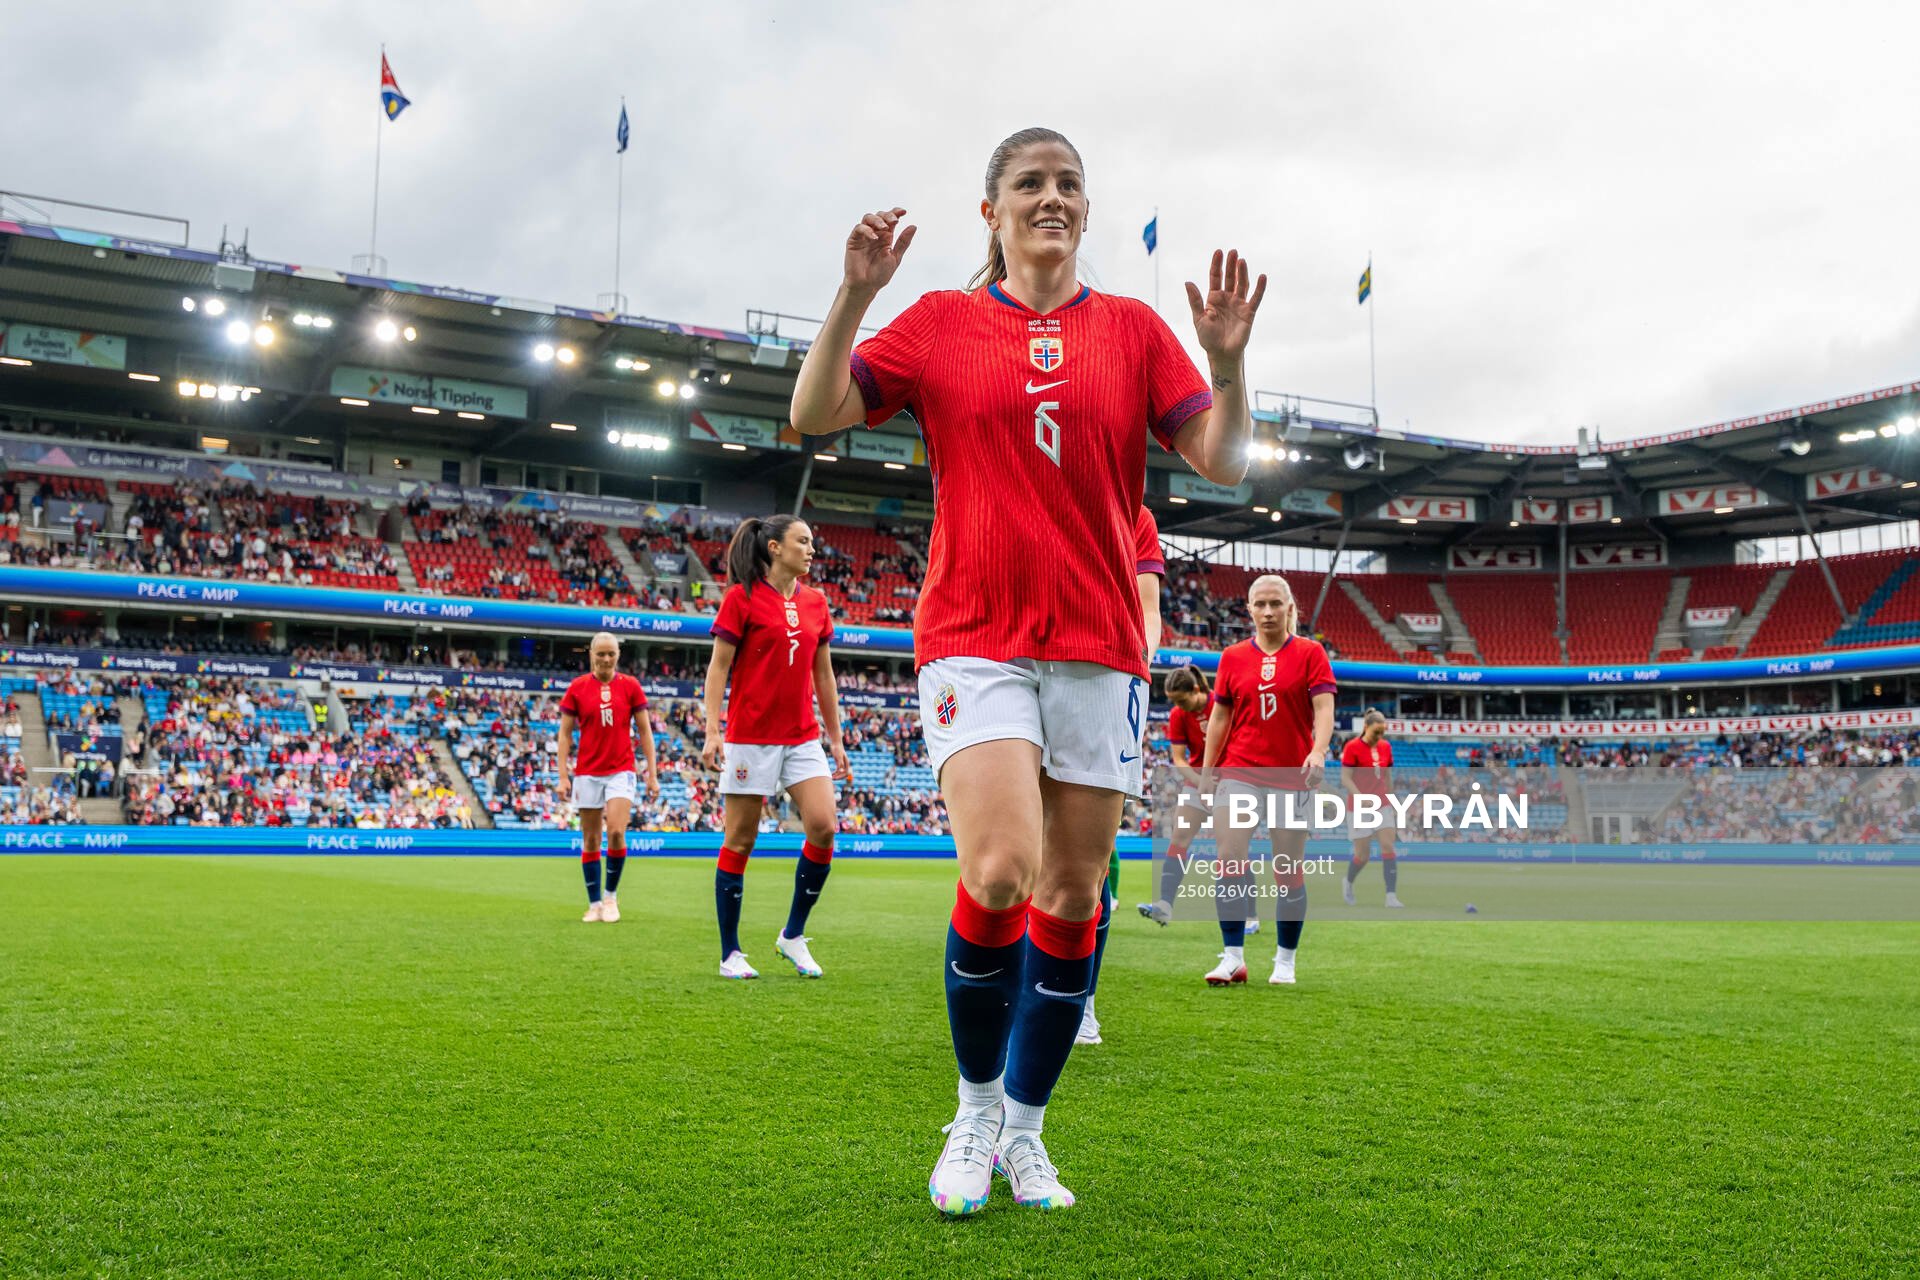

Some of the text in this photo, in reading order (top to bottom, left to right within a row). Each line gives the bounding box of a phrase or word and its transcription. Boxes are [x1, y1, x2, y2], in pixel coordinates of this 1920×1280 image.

[394, 382, 494, 411] Norsk Tipping
[1034, 401, 1061, 468] 6
[1669, 488, 1757, 511] VG
[1388, 499, 1467, 519] VG
[1522, 497, 1603, 523] VG
[1453, 549, 1536, 567] VG
[1576, 545, 1661, 567] VG
[138, 582, 187, 598] PEACE
[384, 599, 427, 614] PEACE
[602, 615, 641, 629] PEACE
[16, 652, 79, 667] Norsk Tipping
[788, 639, 800, 667] 7
[117, 657, 177, 671] Norsk Tipping
[212, 663, 270, 676] Norsk Tipping
[391, 671, 443, 684] Norsk Tipping
[474, 675, 525, 689] Norsk Tipping
[1259, 692, 1277, 720] 13
[601, 708, 613, 727] 18
[1769, 716, 1811, 730] VG
[1820, 713, 1860, 727] VG
[1870, 710, 1912, 724] VG
[1412, 721, 1451, 733] VG
[1460, 722, 1500, 734] VG
[1509, 723, 1551, 734] VG
[1560, 723, 1602, 734] VG
[1613, 722, 1656, 733] VG
[1666, 721, 1709, 733] VG
[1719, 718, 1760, 731] VG
[5, 832, 65, 848] PEACE
[307, 834, 359, 849] PEACE
